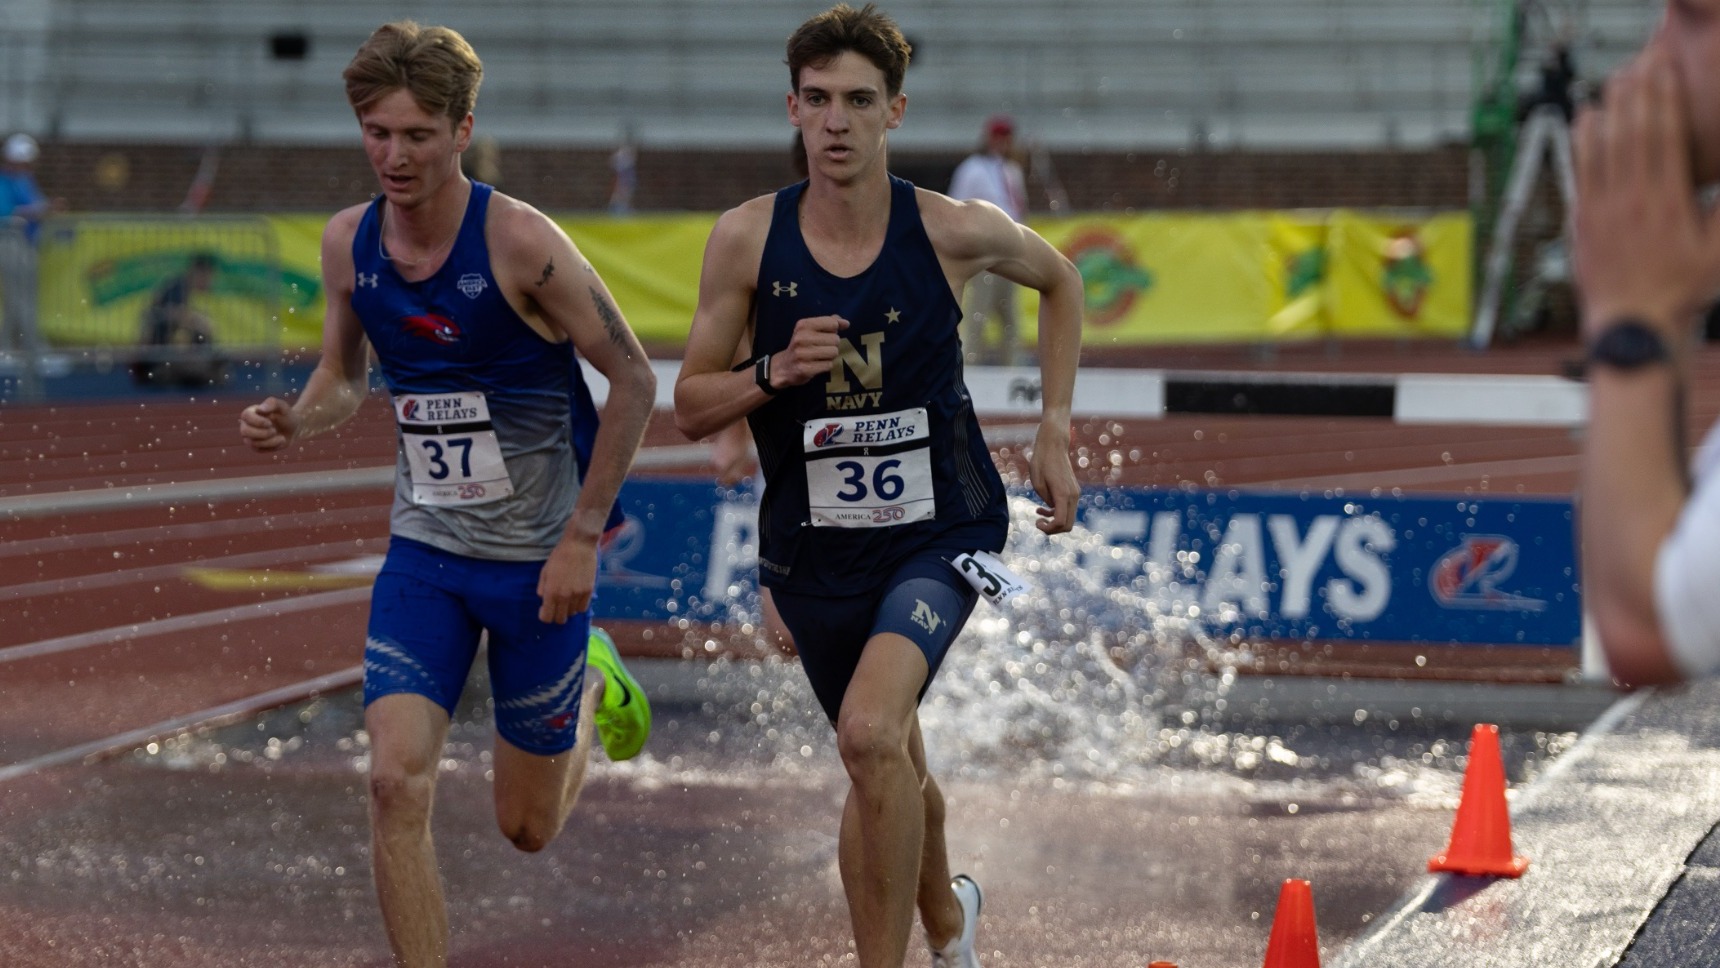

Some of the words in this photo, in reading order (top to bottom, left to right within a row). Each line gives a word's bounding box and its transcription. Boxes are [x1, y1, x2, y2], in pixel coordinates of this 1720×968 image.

[826, 331, 885, 393] N
[426, 398, 462, 410] PENN
[826, 391, 883, 410] NAVY
[427, 407, 478, 421] RELAYS
[854, 416, 901, 432] PENN
[852, 425, 915, 443] RELAYS
[421, 437, 474, 480] 37
[835, 459, 905, 502] 36
[872, 506, 906, 523] 250
[910, 614, 934, 635] NAVY
[911, 598, 941, 632] N
